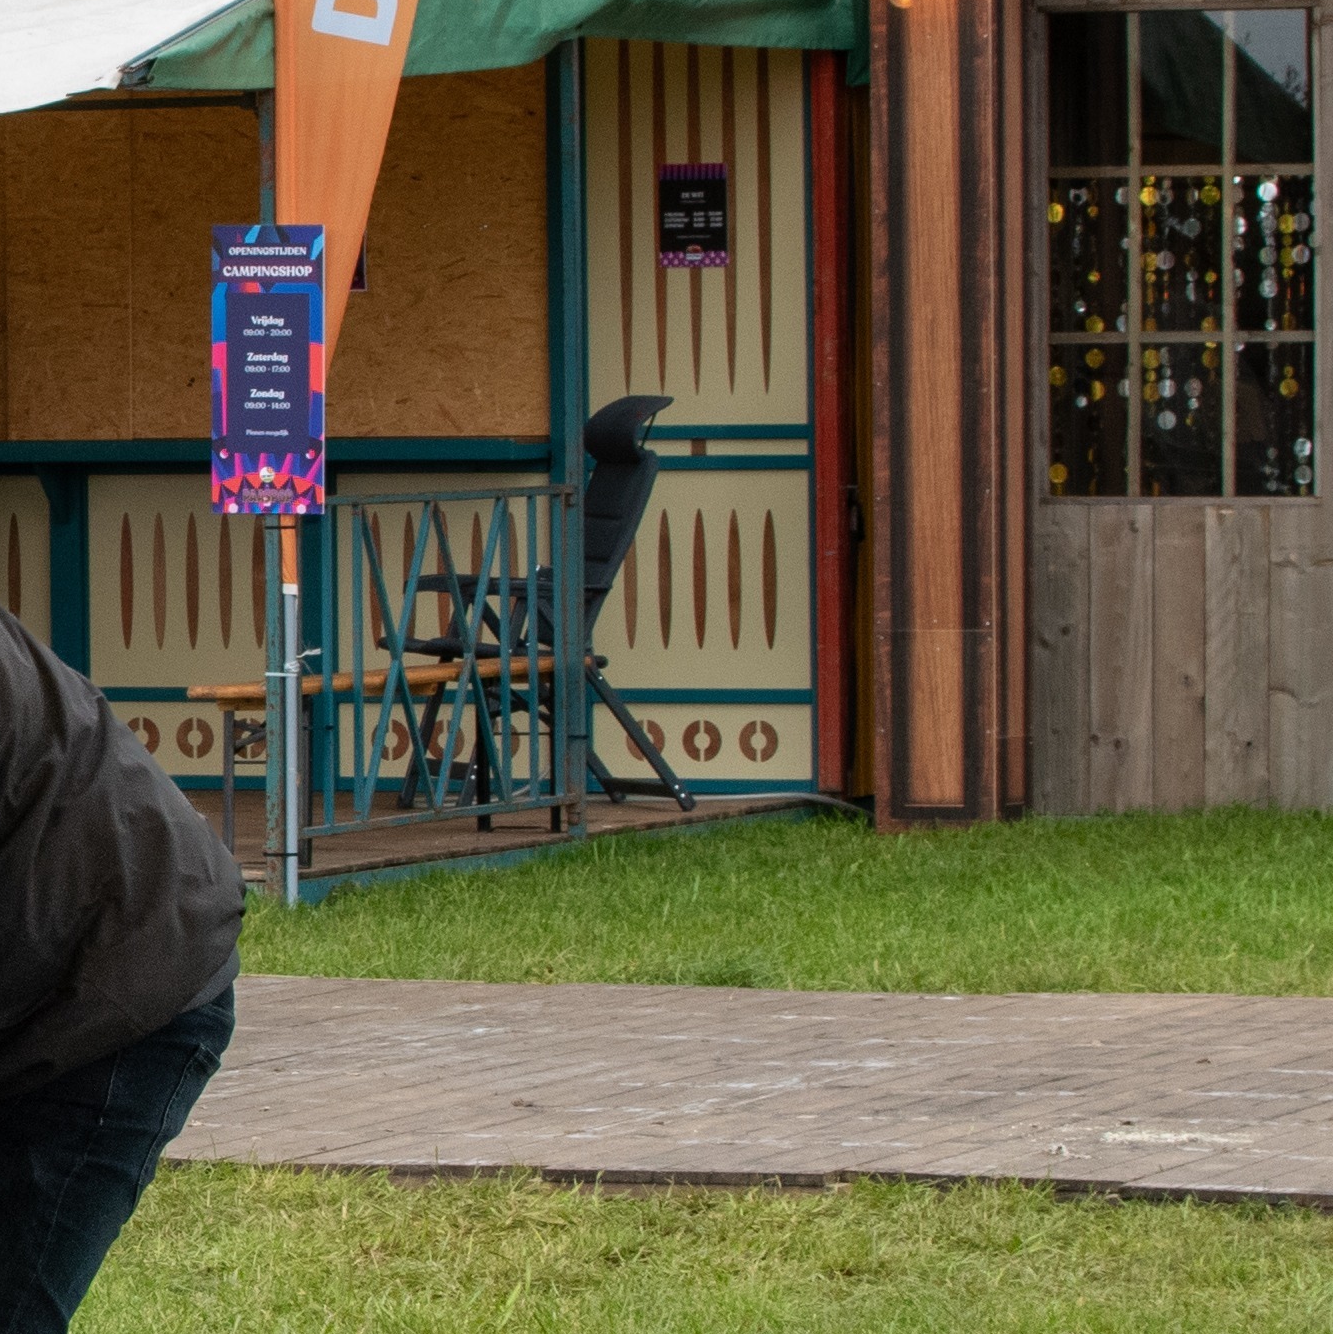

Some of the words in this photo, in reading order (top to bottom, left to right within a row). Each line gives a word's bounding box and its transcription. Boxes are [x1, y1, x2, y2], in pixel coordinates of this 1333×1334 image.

[228, 246, 308, 257] OPENINGSTIJDEN
[223, 265, 313, 278] CAMPINGSHOP
[251, 315, 285, 327] Vrijdag
[246, 352, 289, 364] Zaterdag
[250, 388, 285, 400] Zondag
